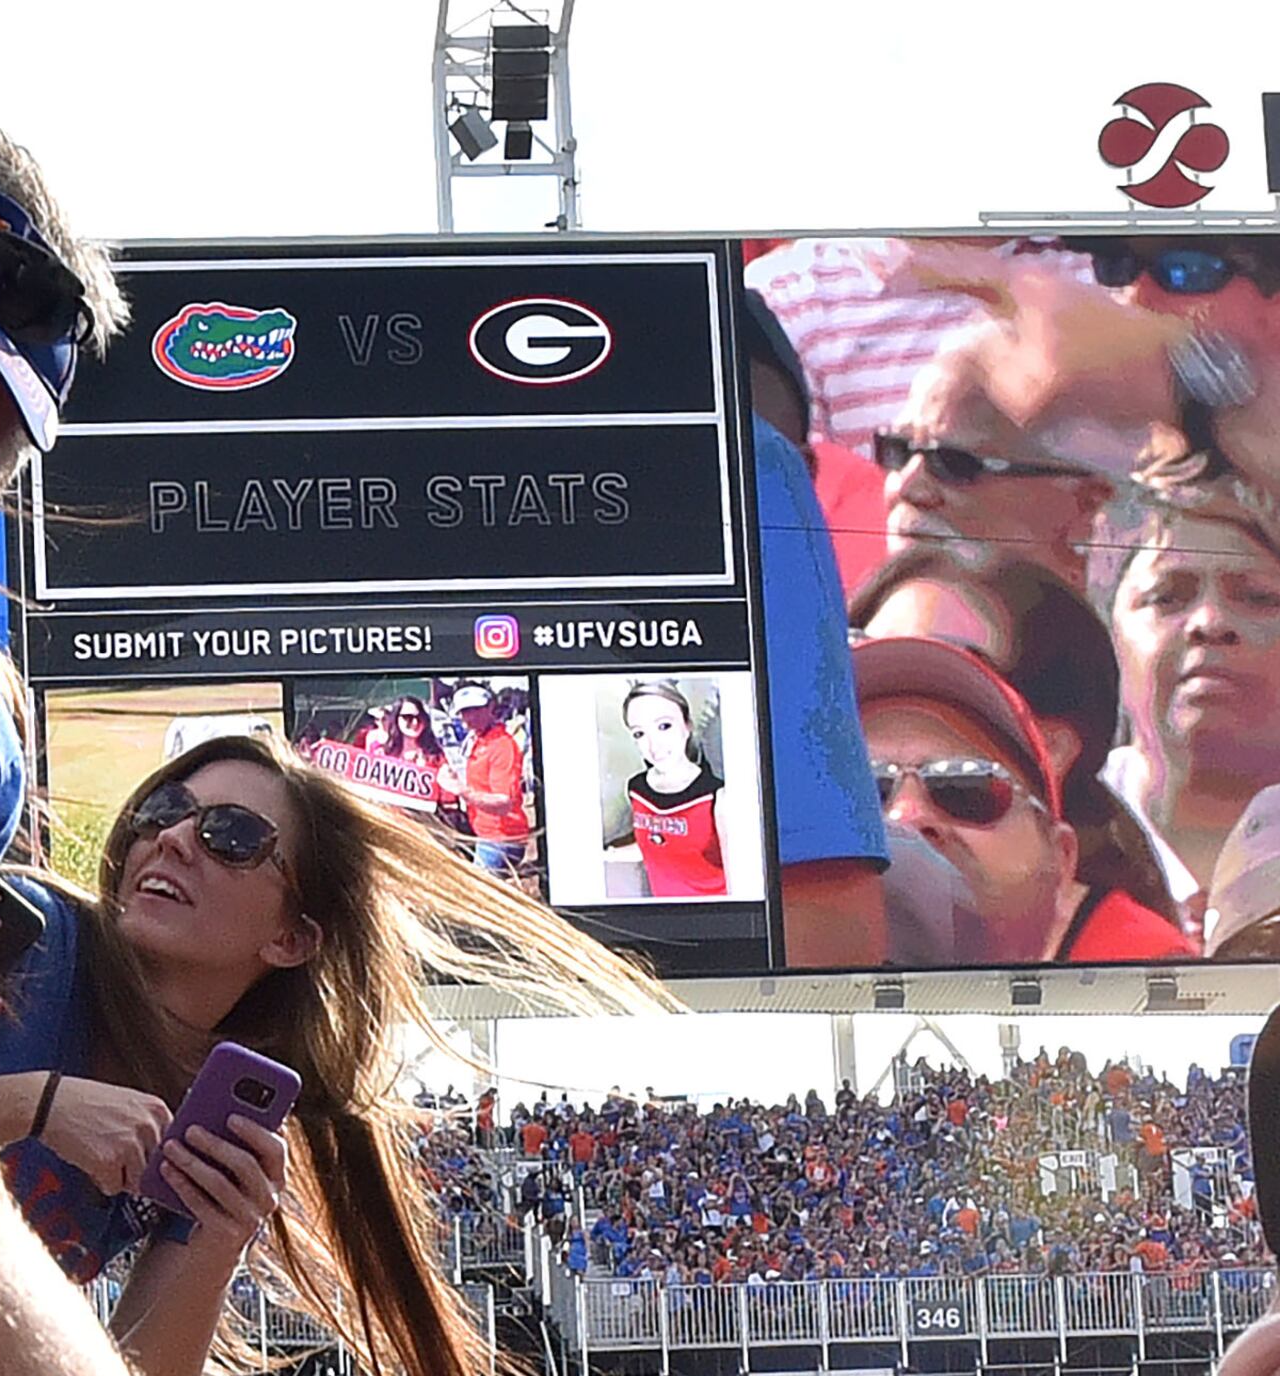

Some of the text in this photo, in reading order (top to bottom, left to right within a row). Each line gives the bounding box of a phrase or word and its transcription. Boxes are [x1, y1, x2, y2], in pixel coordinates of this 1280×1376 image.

[337, 311, 425, 367] VS
[148, 472, 630, 533] PLAYER STATS
[73, 625, 433, 660] SUBMIT YOUR PICTURES!
[532, 619, 703, 650] #UFVSUGA
[319, 746, 433, 797] GO DAWGS
[916, 1307, 961, 1329] 346
